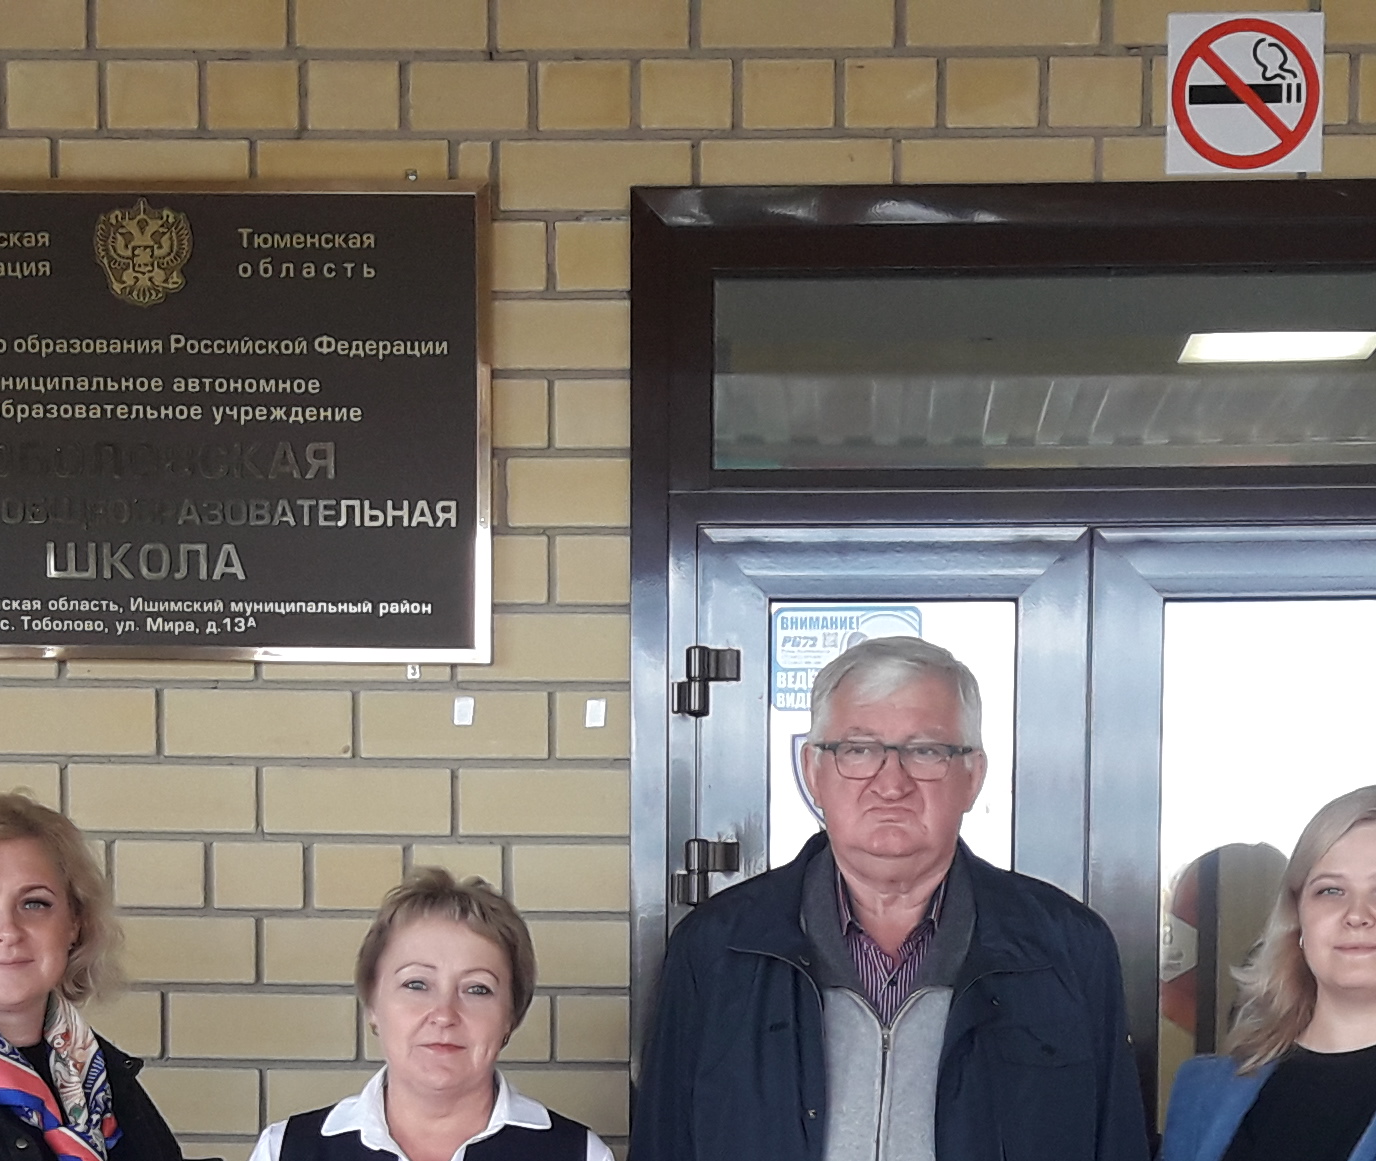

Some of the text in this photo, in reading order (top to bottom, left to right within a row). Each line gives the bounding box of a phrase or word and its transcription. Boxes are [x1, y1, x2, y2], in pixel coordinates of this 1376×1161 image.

[237, 228, 375, 249] Тюменская
[237, 256, 376, 279] область
[13, 334, 163, 357] образования
[169, 333, 308, 354] Российской
[314, 334, 449, 360] Федерации
[172, 376, 321, 394] автономное
[212, 405, 363, 425] учреждение
[0, 497, 458, 531] ОБЩОАЗОВАТЕЛЬНАЯ
[45, 541, 247, 581] ШКОЛА
[48, 596, 124, 614] область,
[129, 597, 224, 613] Ишимский
[230, 600, 373, 616] муниципальный
[379, 600, 432, 617] район
[0, 619, 15, 631] с.
[20, 616, 109, 634] Тоболово,
[115, 620, 140, 635] ул.
[146, 617, 200, 635] Мира,
[780, 616, 860, 631] ВНИМАНИЕ!
